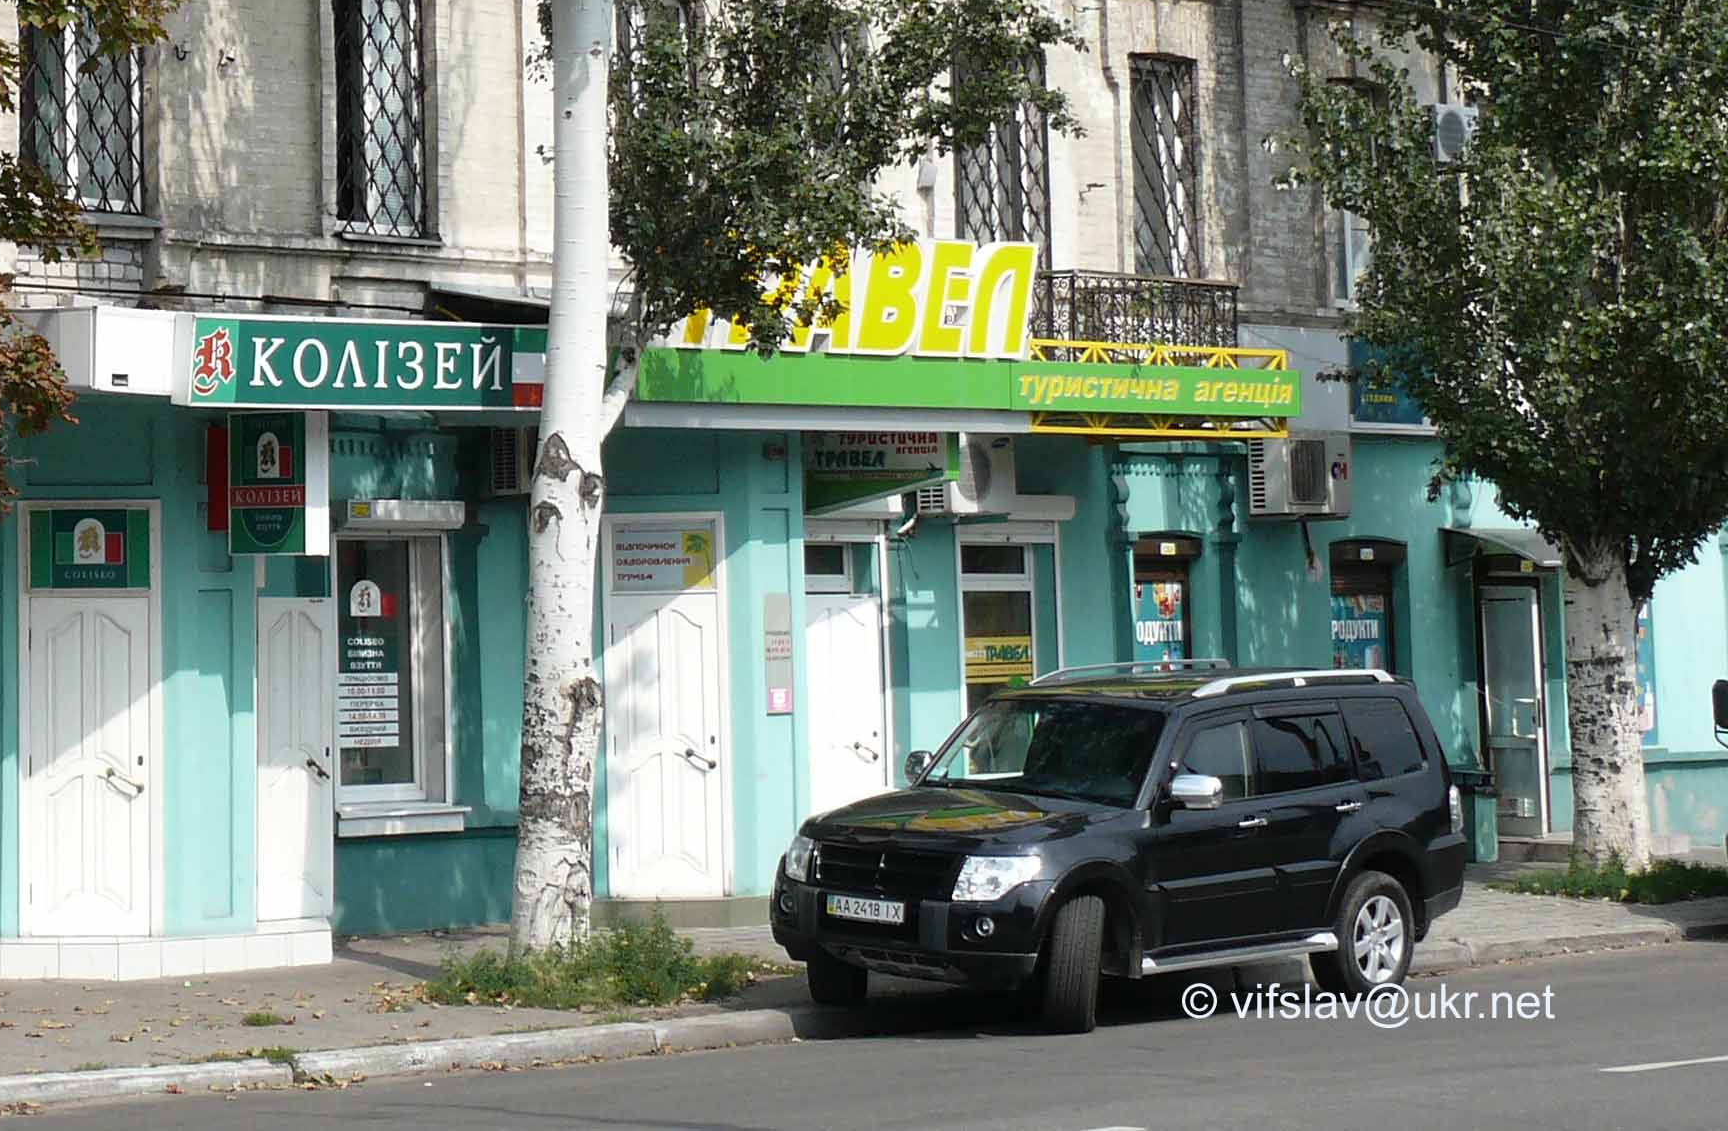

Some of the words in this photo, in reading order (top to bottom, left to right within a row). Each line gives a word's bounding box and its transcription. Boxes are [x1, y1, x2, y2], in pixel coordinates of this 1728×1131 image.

[249, 335, 504, 391] КОЛІЗЕЙ
[1019, 374, 1181, 406] туристична
[1194, 377, 1293, 408] агенція
[814, 449, 887, 468] ТРАВЕЛ
[234, 489, 302, 503] КОЛІЗЕЙ
[347, 637, 385, 646] COLISEO
[836, 898, 850, 914] AA
[853, 901, 880, 917] 2418
